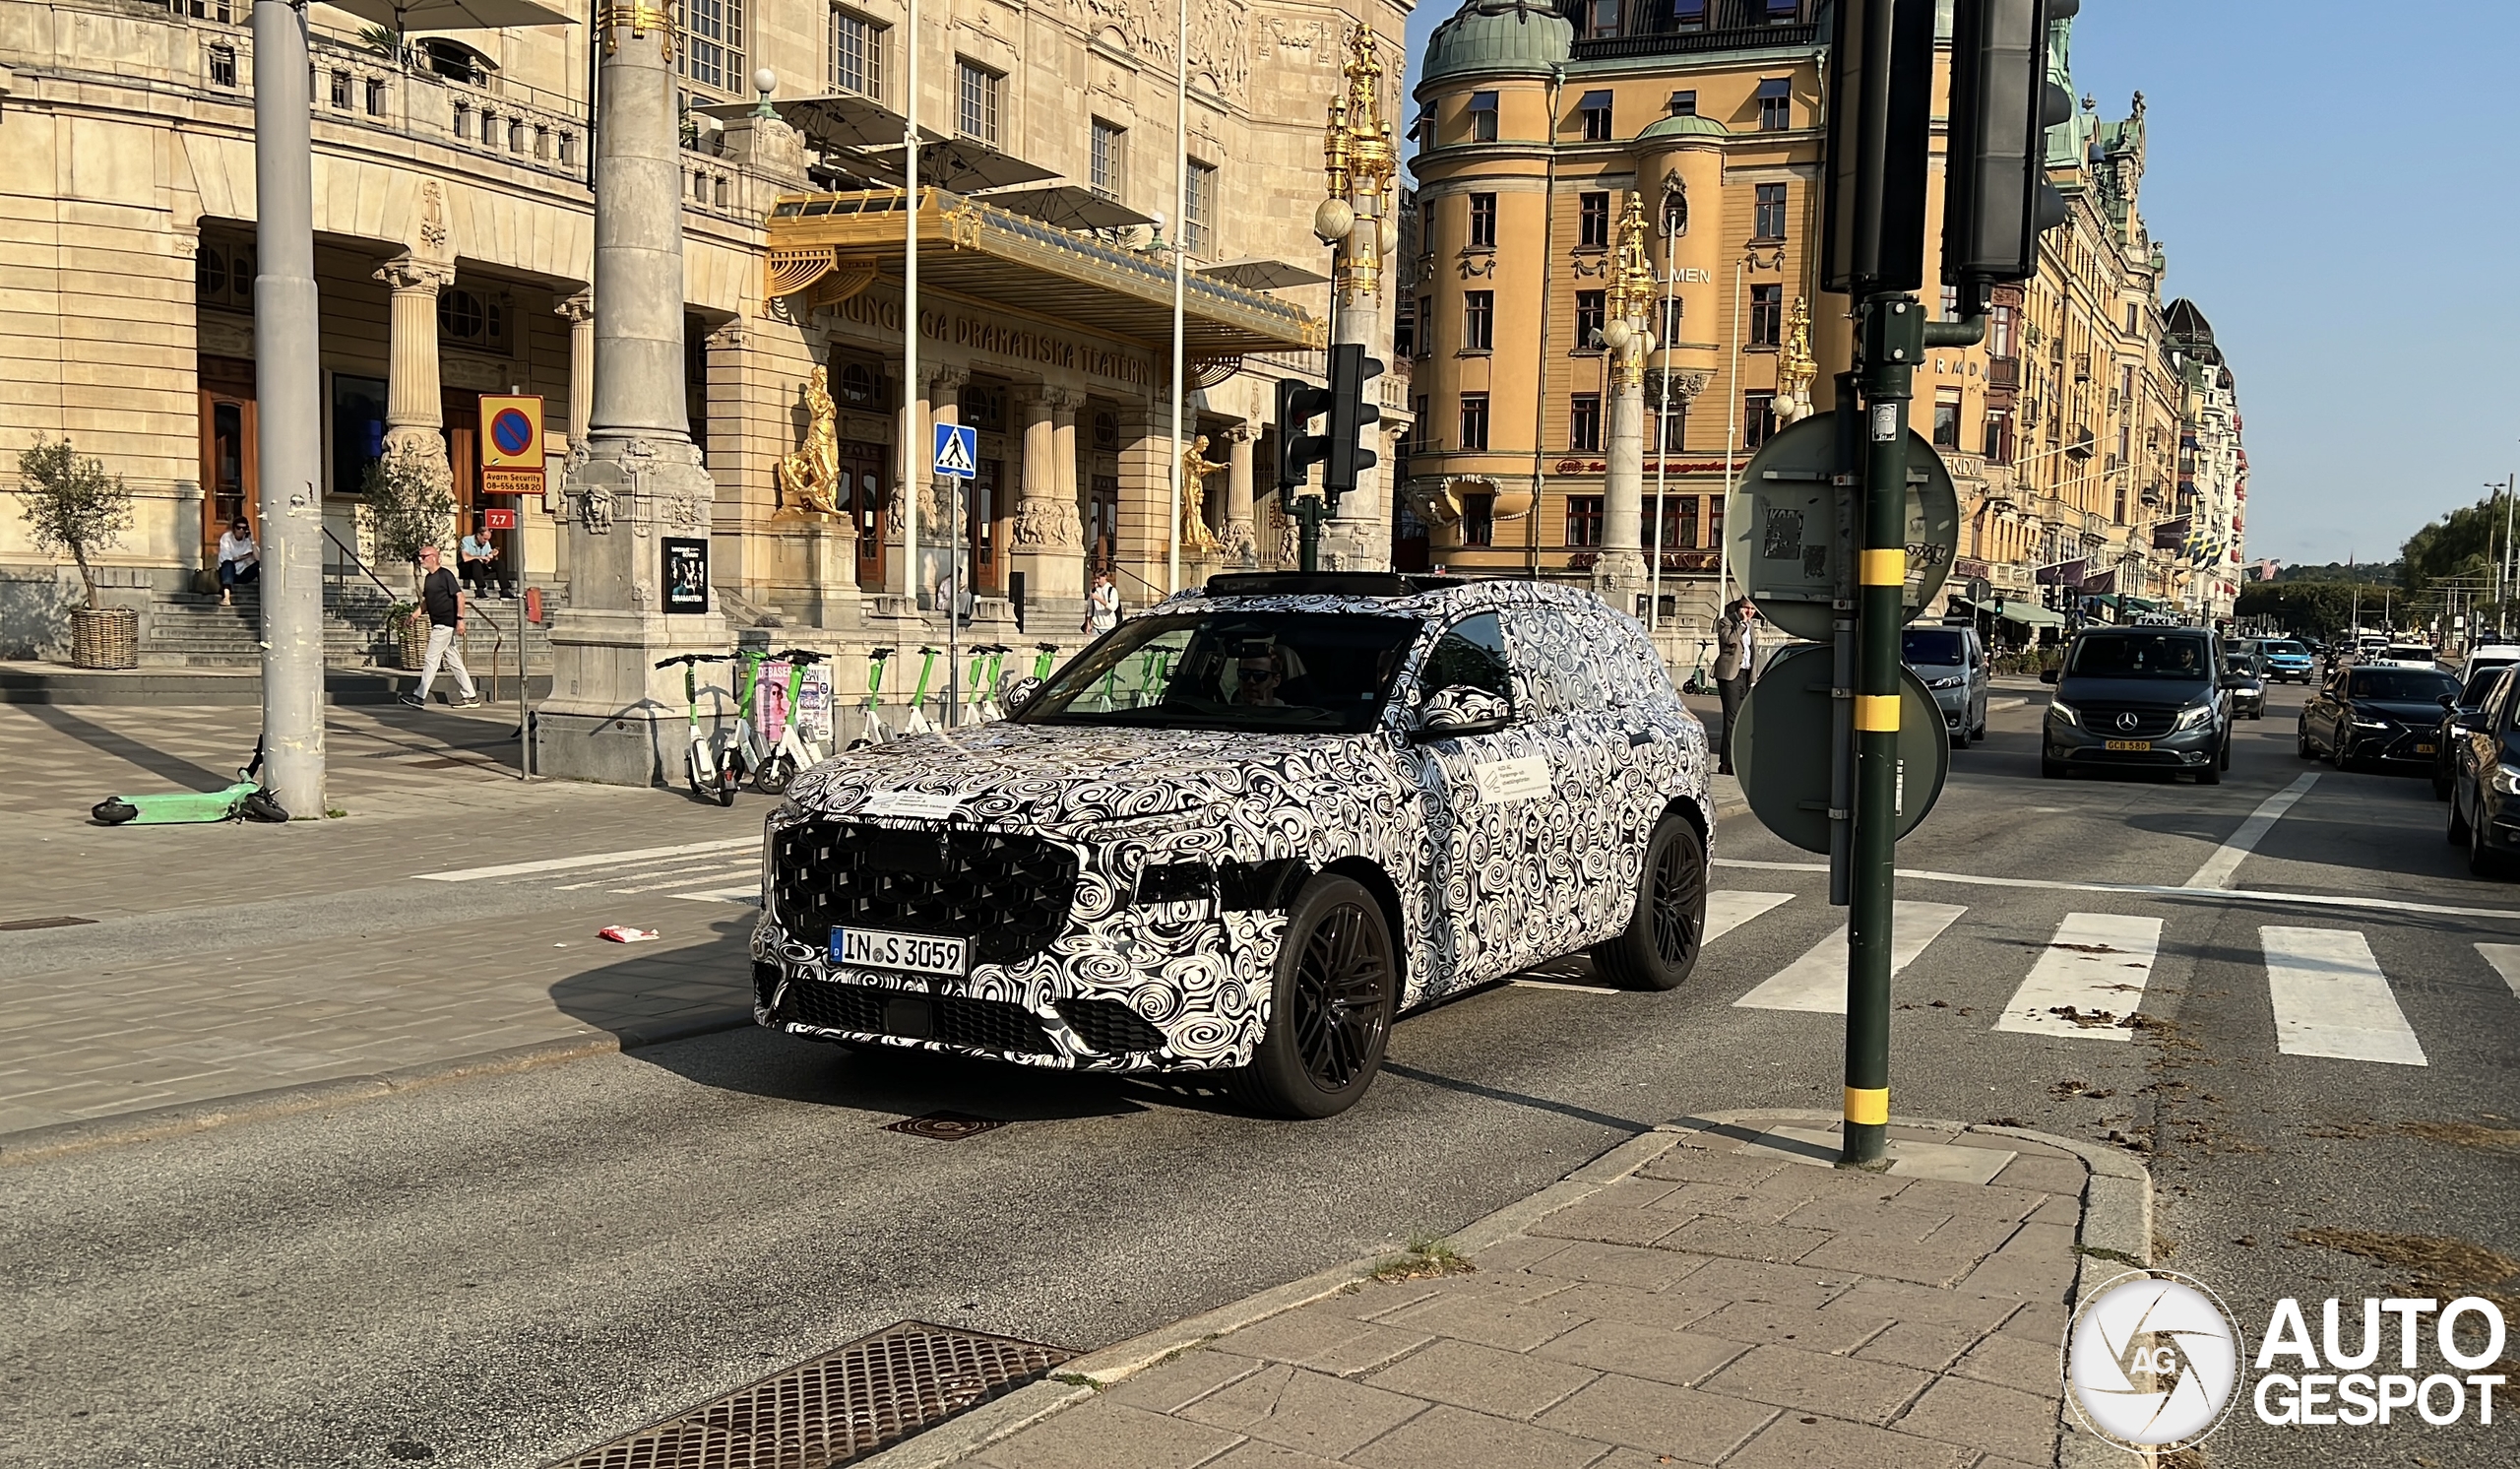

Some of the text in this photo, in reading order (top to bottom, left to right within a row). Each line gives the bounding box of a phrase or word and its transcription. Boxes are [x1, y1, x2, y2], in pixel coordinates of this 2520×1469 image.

[956, 316, 1076, 369] DRAMATISKA
[1080, 344, 1149, 386] TEATERN
[486, 473, 541, 483] Avarn Security
[486, 481, 515, 490] 08-556
[516, 482, 530, 491] 558
[834, 947, 840, 957] D
[845, 932, 960, 971] IN S 3059
